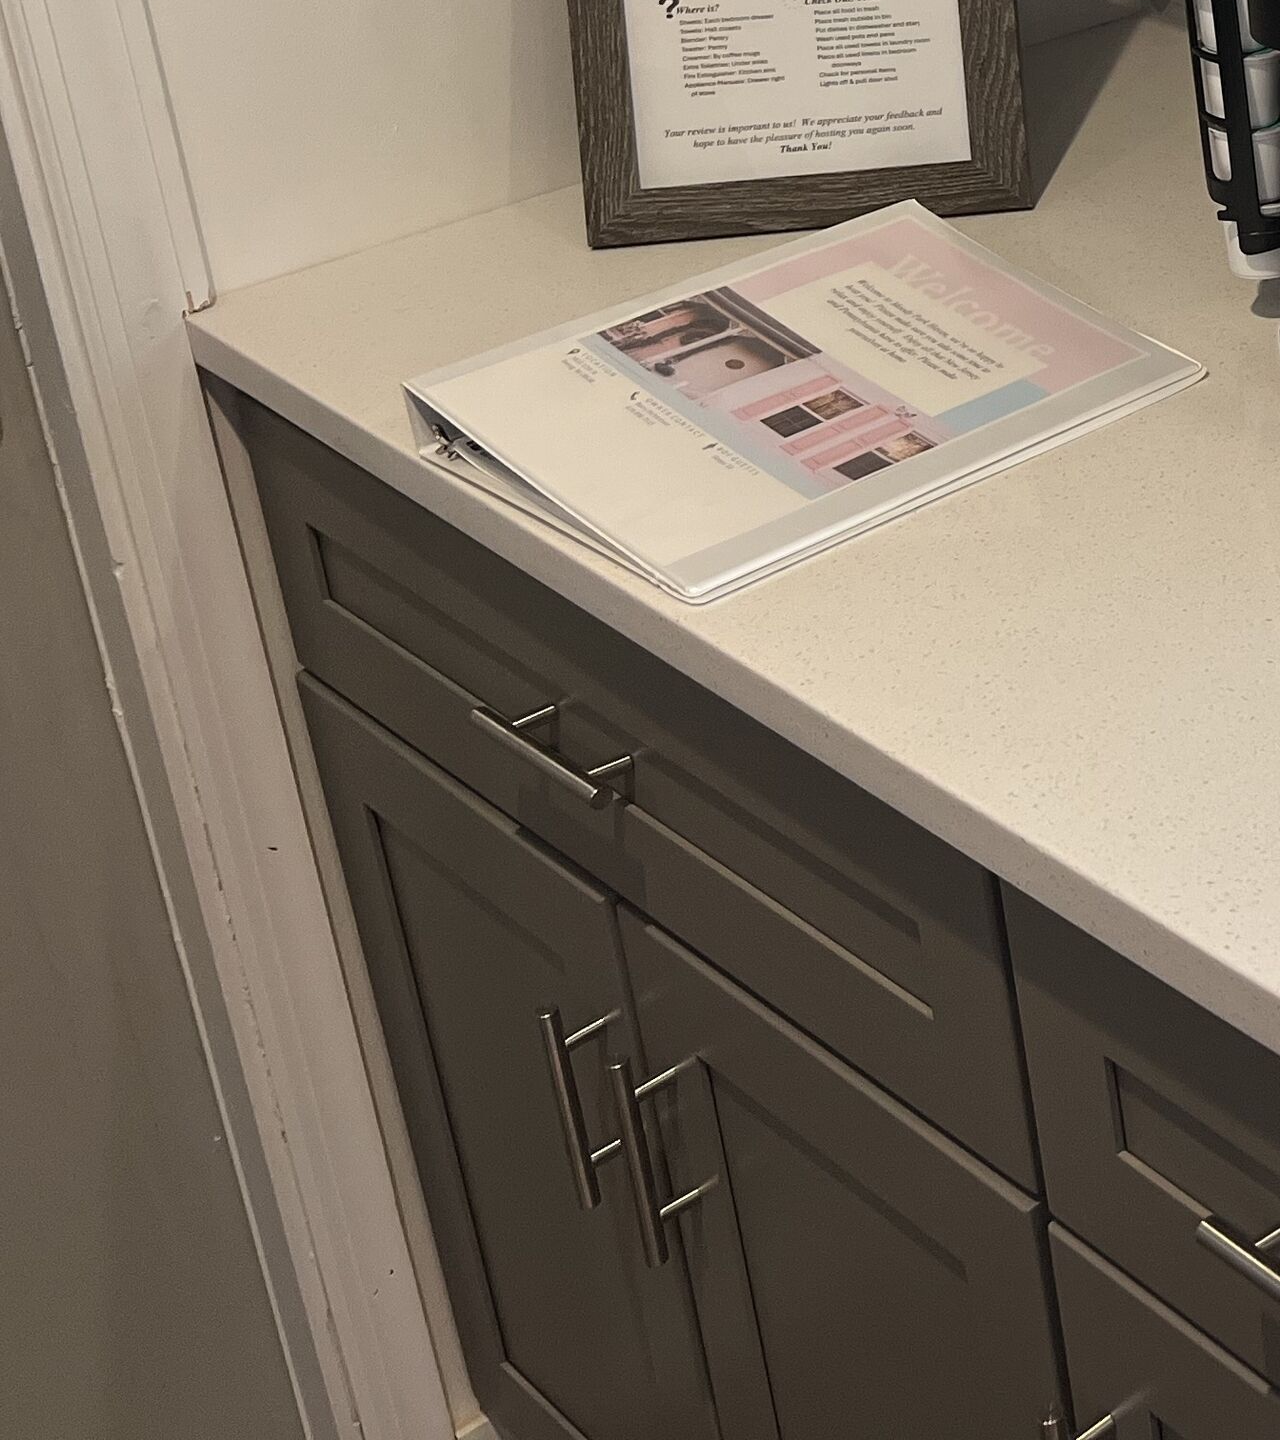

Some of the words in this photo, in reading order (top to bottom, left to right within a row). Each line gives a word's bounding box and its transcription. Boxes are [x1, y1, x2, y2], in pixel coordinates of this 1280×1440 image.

[676, 5, 705, 15] Where
[664, 129, 686, 138] Your
[687, 126, 716, 136] review
[718, 126, 726, 134] is
[727, 122, 770, 134] important
[772, 121, 781, 129] to
[801, 117, 815, 126] We
[817, 115, 863, 127] appreciate
[863, 114, 885, 124] your
[885, 108, 924, 121] feedback
[926, 107, 943, 116] and
[693, 140, 715, 150] hope
[716, 138, 726, 146] to
[727, 137, 749, 146] have
[750, 135, 764, 144] the
[764, 133, 802, 145] pleasure
[804, 130, 815, 140] of
[814, 128, 847, 138] hosting
[848, 128, 865, 137] you
[865, 125, 891, 135] again
[892, 123, 916, 132] soon.
[780, 144, 808, 153] Thank
[811, 141, 832, 151] You!
[893, 254, 1056, 361] Welcome
